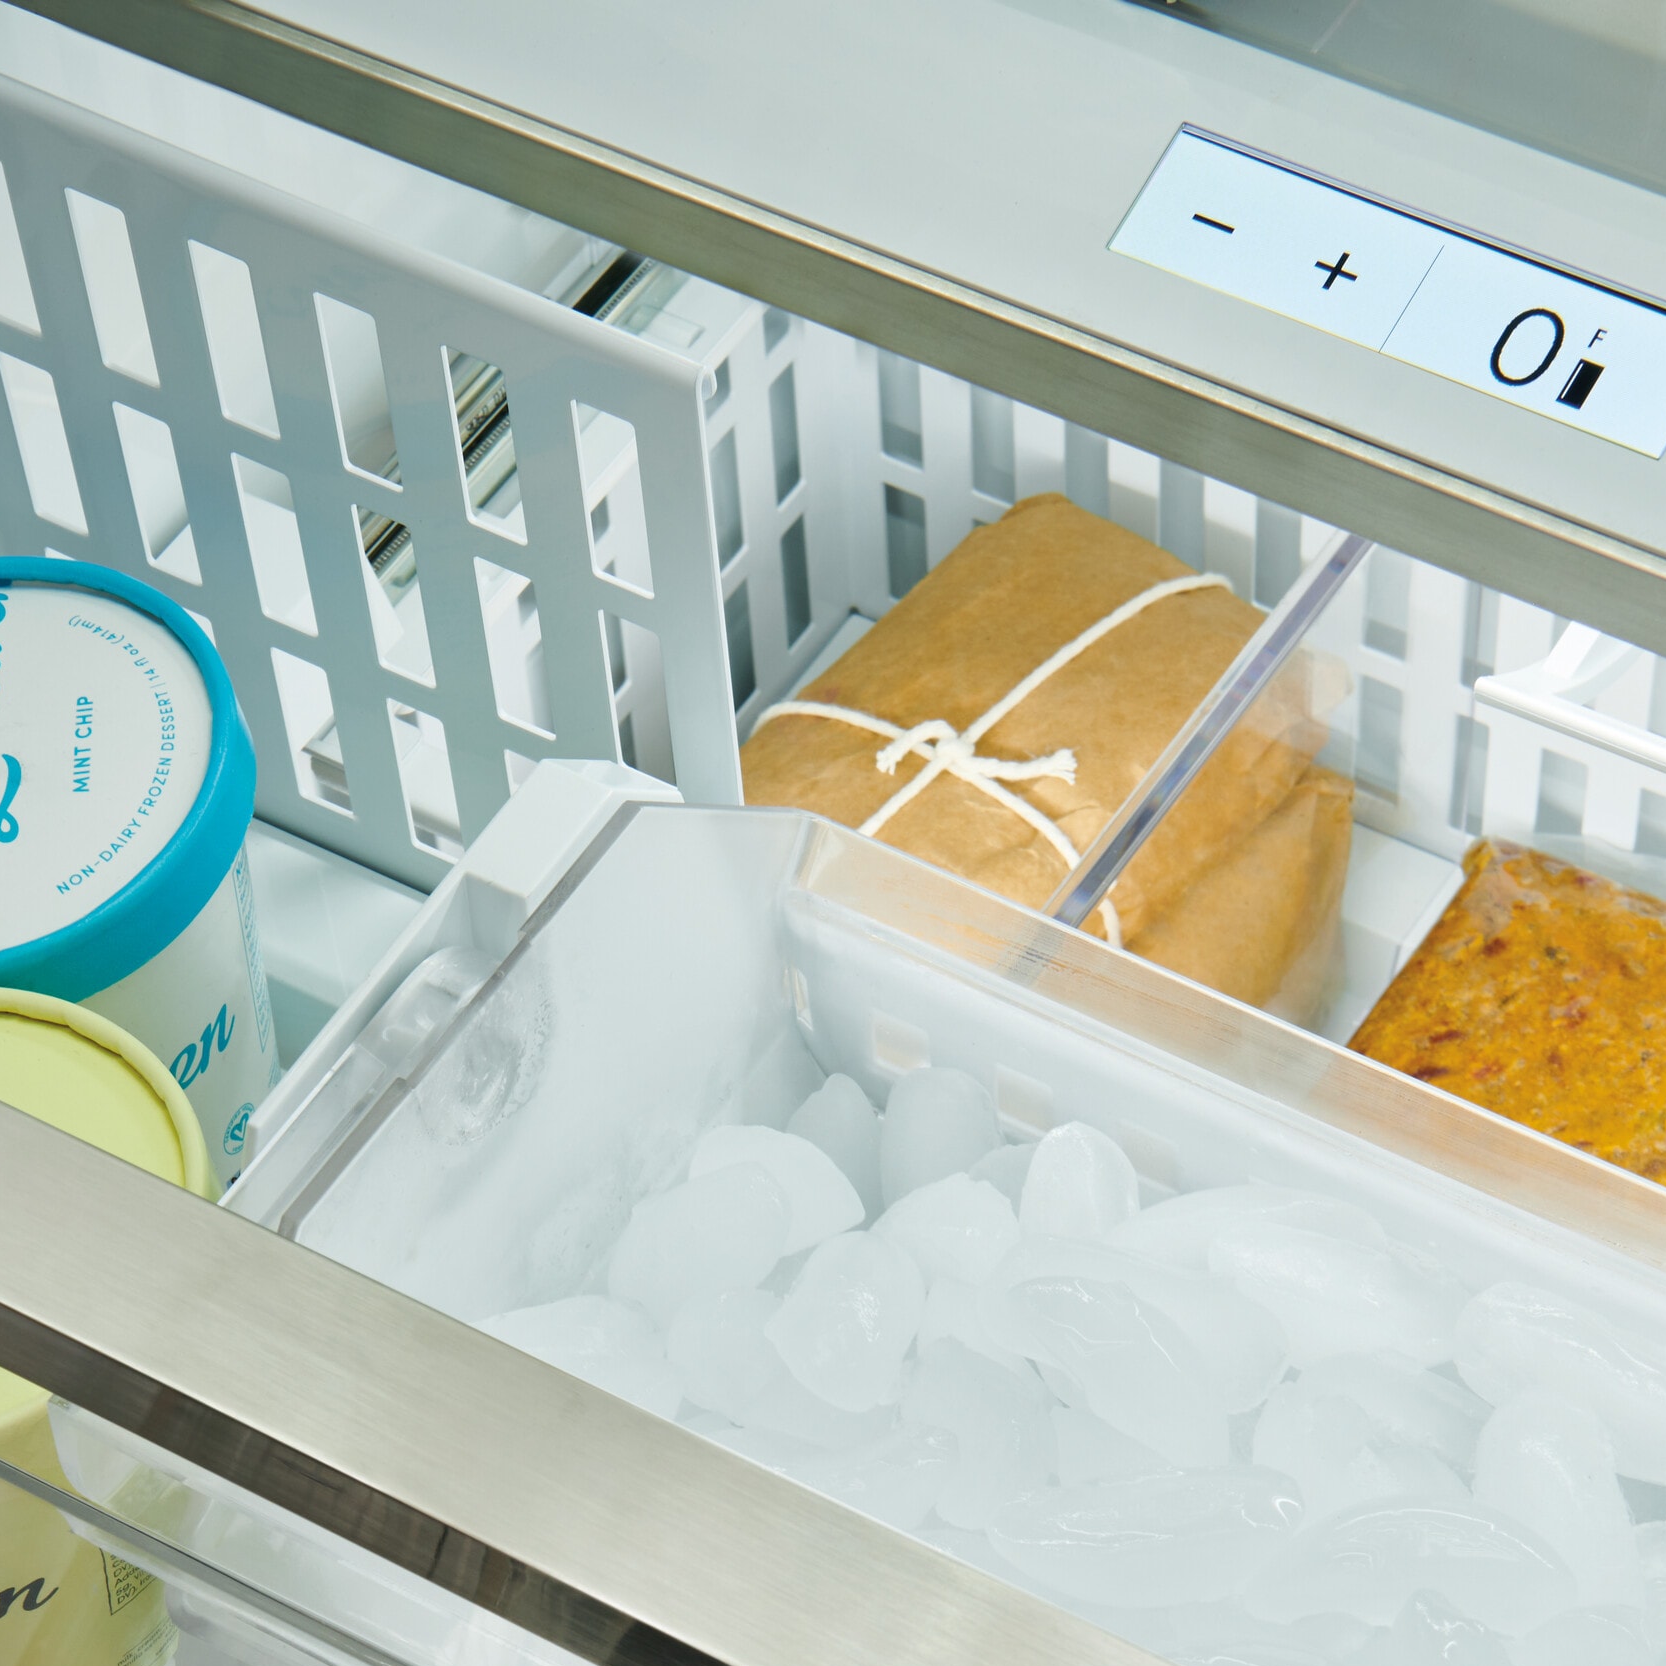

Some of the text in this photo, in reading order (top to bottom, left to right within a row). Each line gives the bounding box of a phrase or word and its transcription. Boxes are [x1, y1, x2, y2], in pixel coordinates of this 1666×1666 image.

[1588, 328, 1608, 349] F
[68, 614, 126, 645] (414ml)
[122, 642, 139, 656] oz
[72, 696, 94, 793] MINT CHIP
[154, 690, 176, 751] DESSERT
[137, 757, 172, 816] FROZEN
[56, 818, 142, 895] NON-DAIRY
